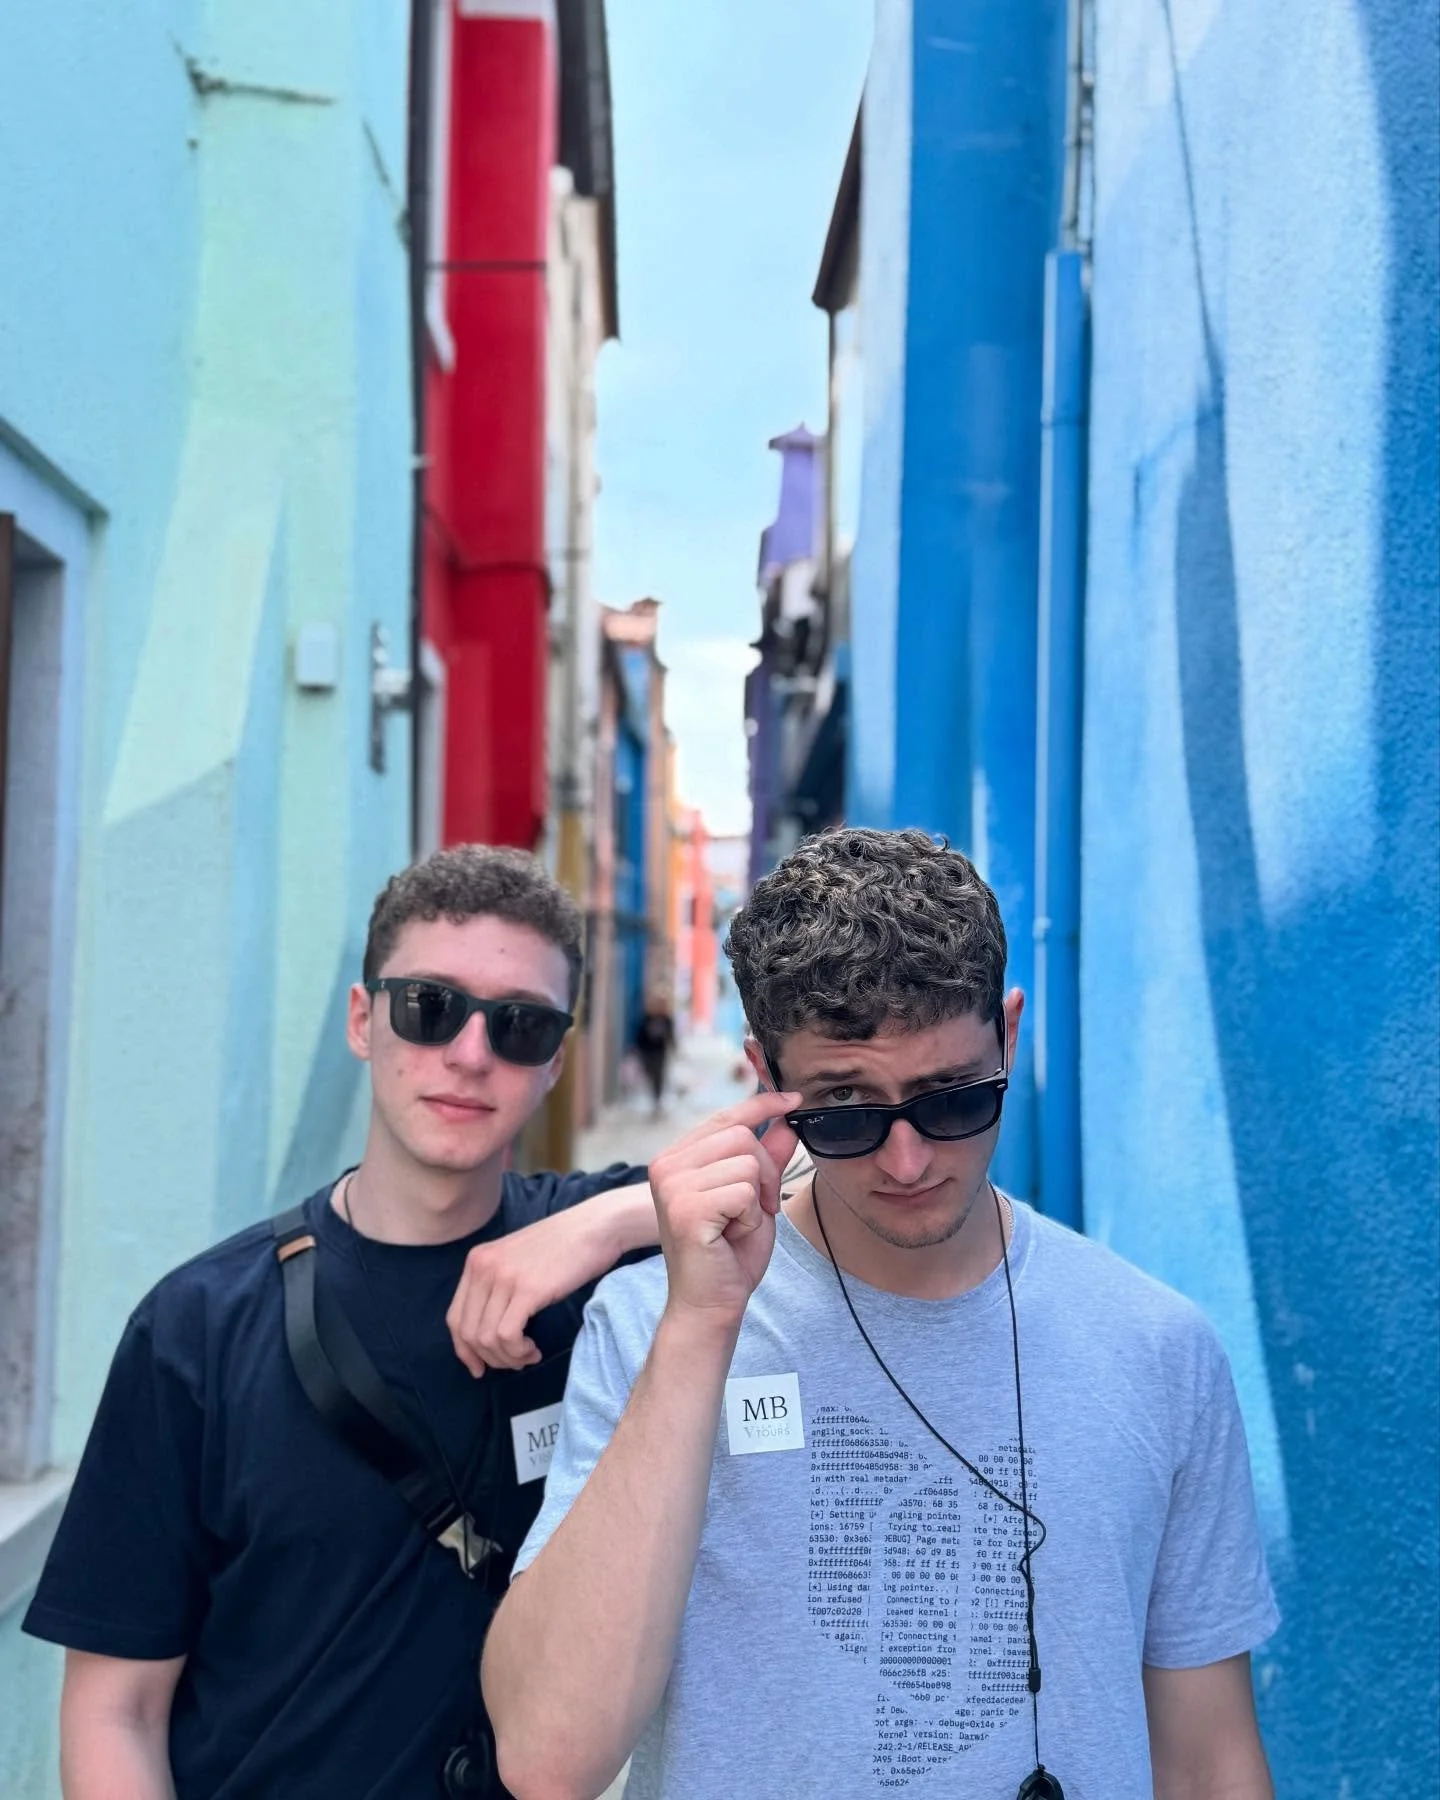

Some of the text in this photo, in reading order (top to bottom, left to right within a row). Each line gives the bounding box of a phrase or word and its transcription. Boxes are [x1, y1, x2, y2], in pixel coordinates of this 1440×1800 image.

[742, 1396, 788, 1422] MB
[874, 1475, 912, 1483] metadat
[830, 1510, 865, 1520] Setting
[1003, 1516, 1024, 1524] Afte
[888, 1522, 917, 1532] Trying
[916, 1536, 936, 1545] Page
[828, 1584, 852, 1592] Using
[974, 1586, 1025, 1598] Connecting
[886, 1596, 934, 1606] Connecting
[918, 1608, 949, 1616] kernel
[898, 1632, 948, 1642] Connecting
[889, 1645, 932, 1653] exception
[878, 1730, 908, 1738] Kernel
[914, 1730, 952, 1739] version:
